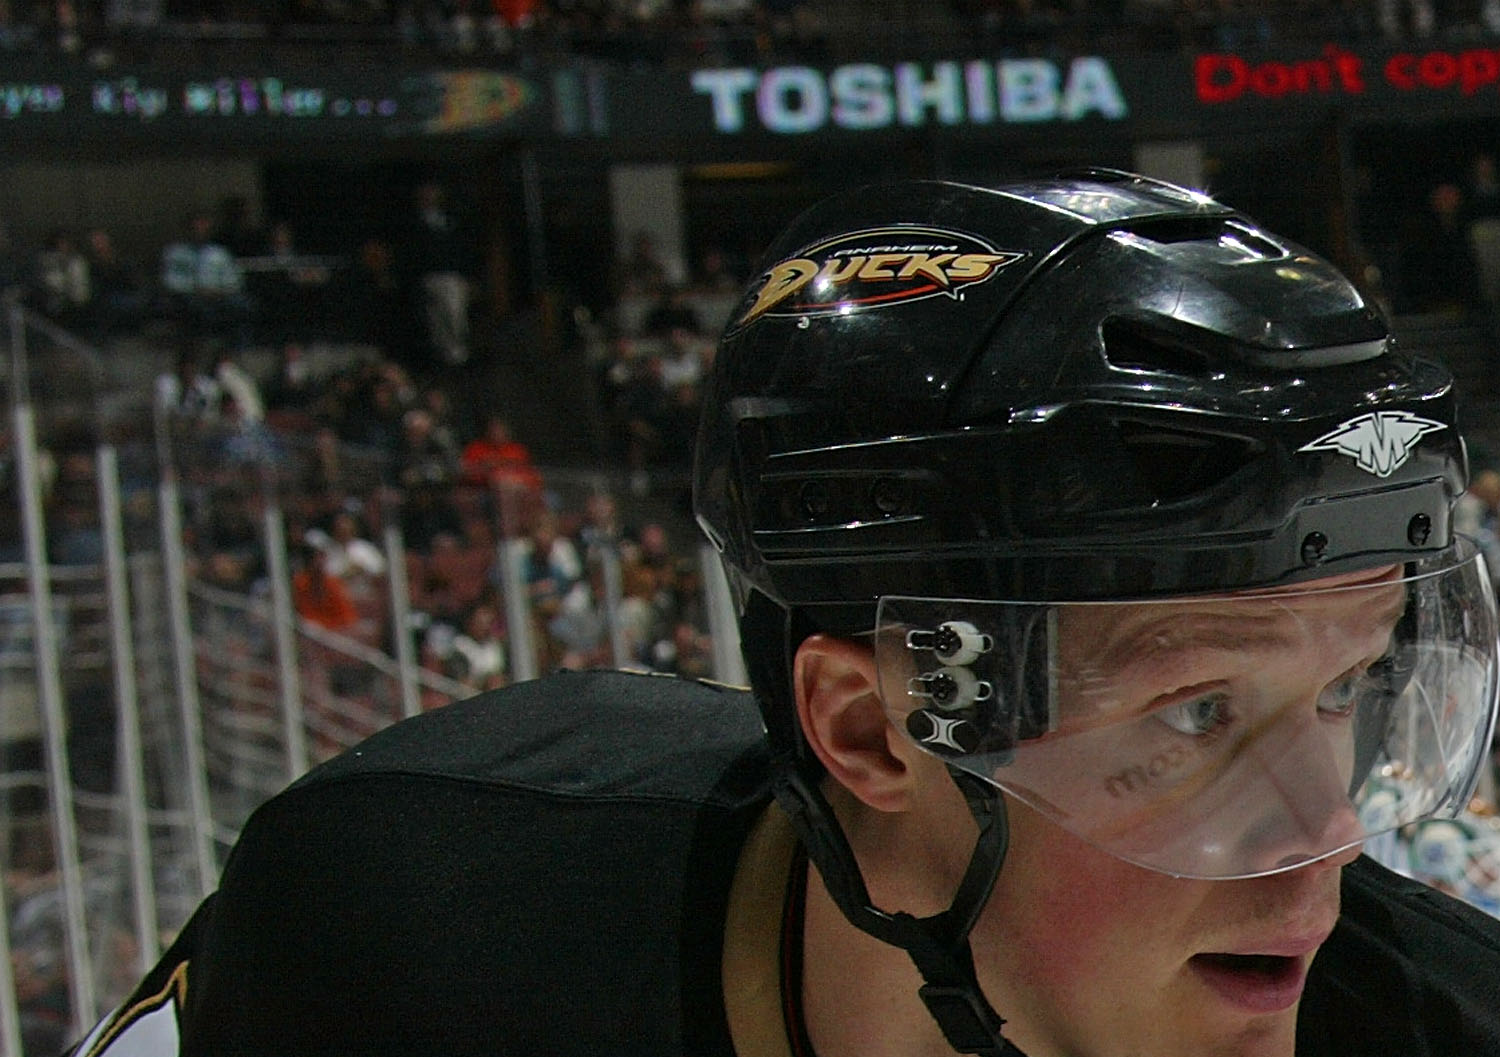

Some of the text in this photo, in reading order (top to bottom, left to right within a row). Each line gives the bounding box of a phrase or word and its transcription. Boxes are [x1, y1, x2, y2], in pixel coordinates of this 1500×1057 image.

[691, 55, 1127, 134] TOSHIBA
[1194, 44, 1364, 101] Don't
[738, 252, 1006, 326] DUCKS
